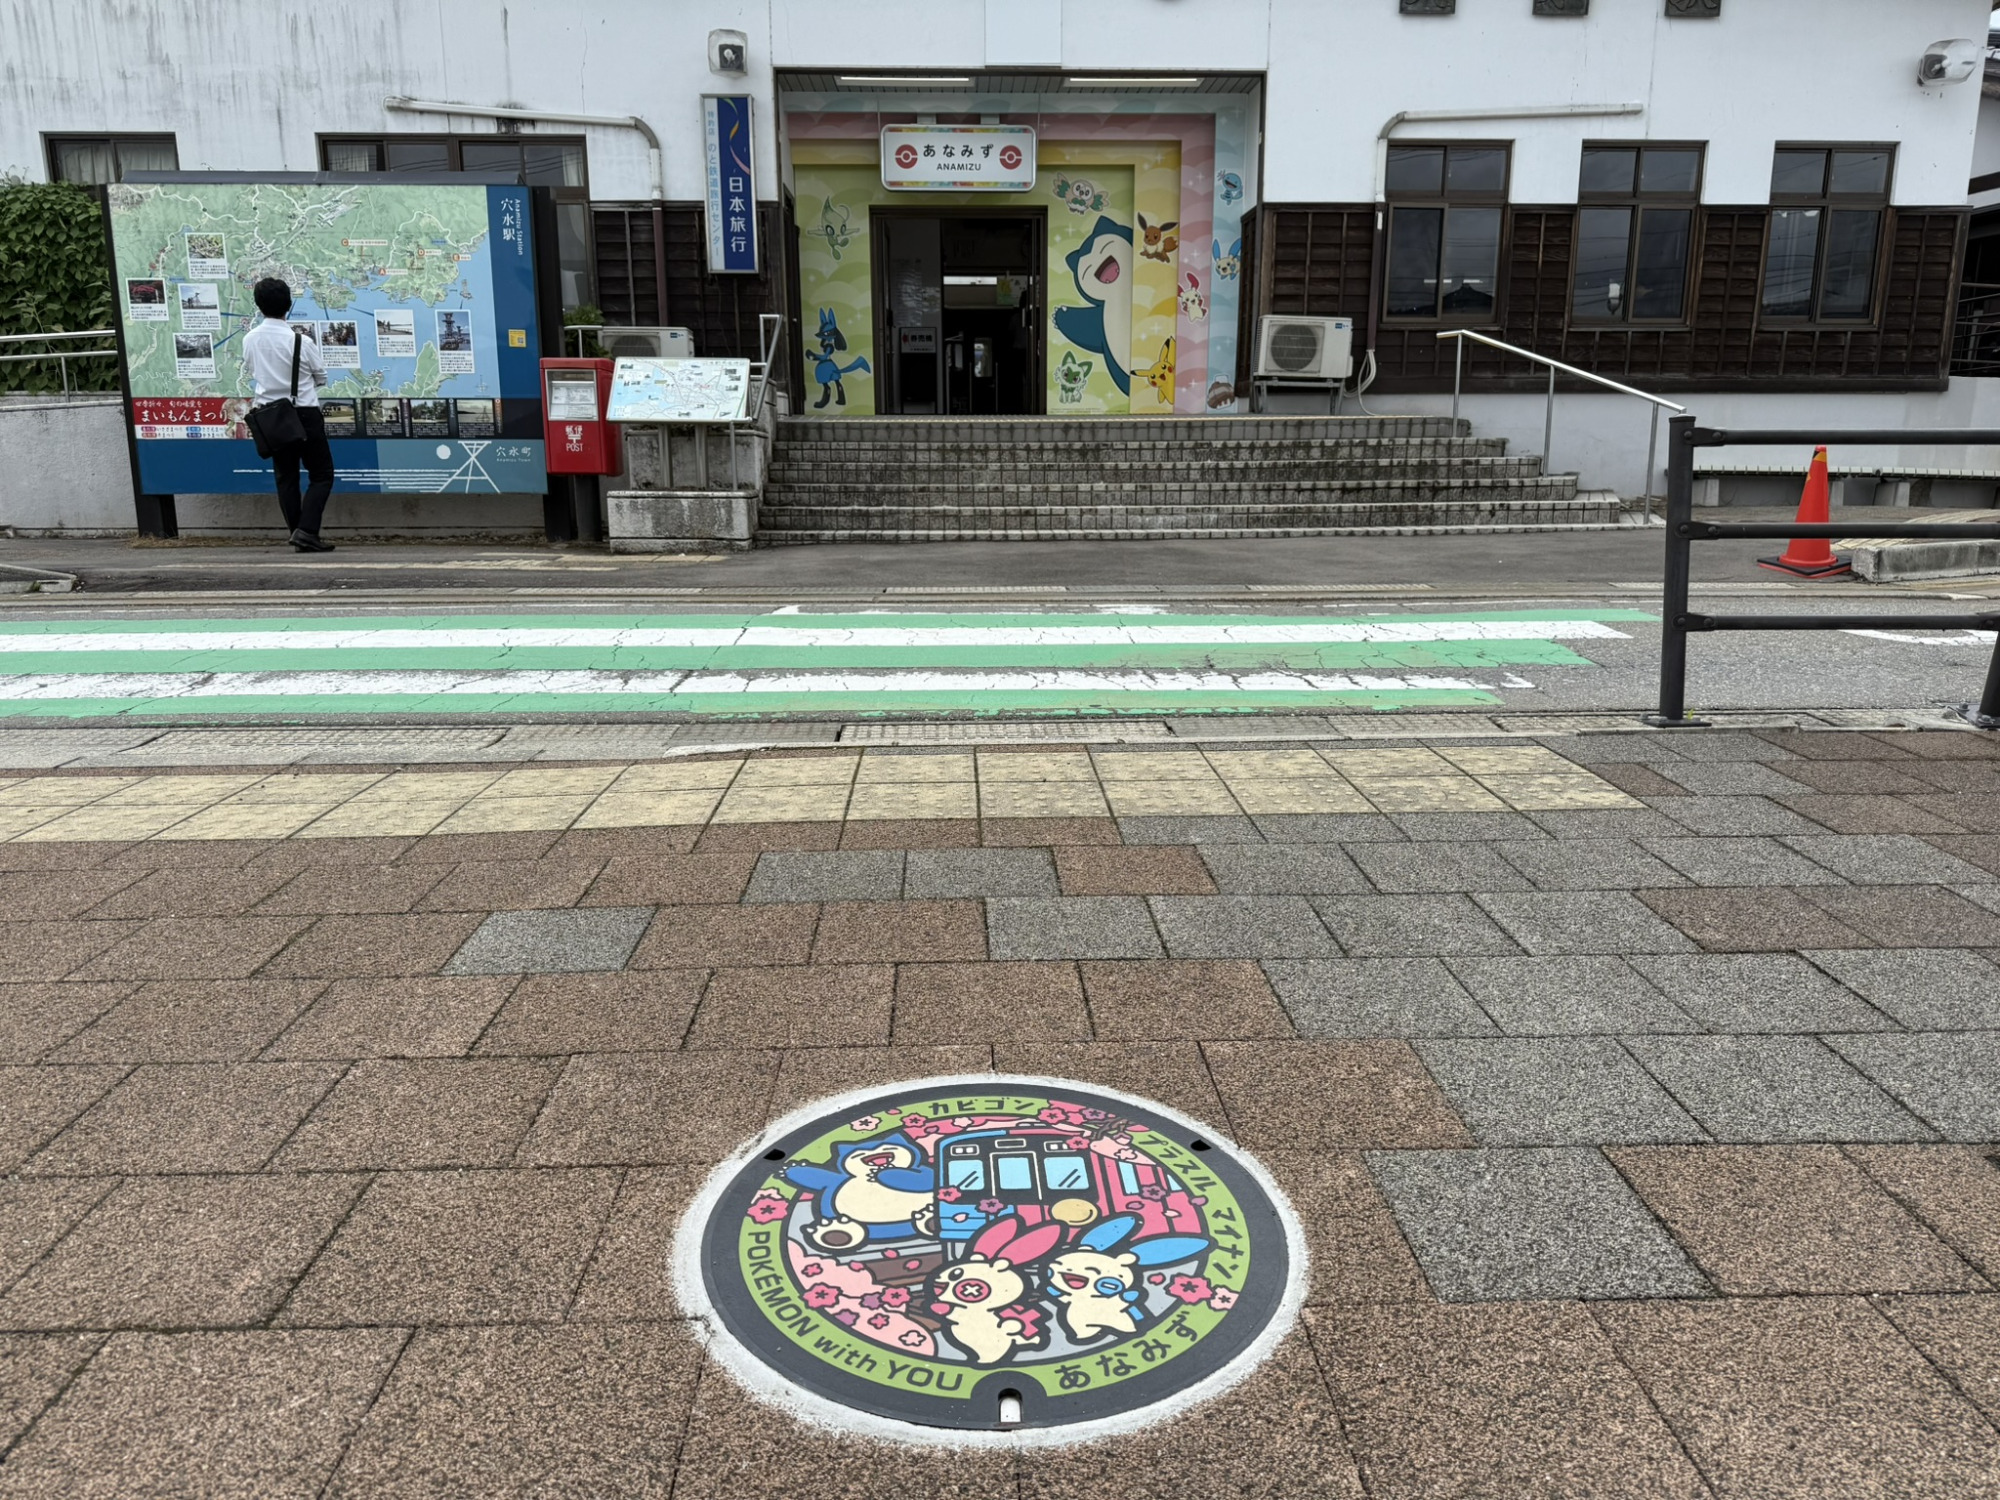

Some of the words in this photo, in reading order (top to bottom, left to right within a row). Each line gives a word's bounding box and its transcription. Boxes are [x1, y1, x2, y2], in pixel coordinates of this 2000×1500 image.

[922, 143, 995, 159] あなみず
[936, 162, 982, 172] ANAMIZU
[514, 198, 522, 230] Anamizu
[708, 143, 721, 256] のと鉄道旅行センター
[500, 197, 516, 241] 穴水駅
[728, 176, 747, 253] 日本旅行
[516, 230, 524, 256] Station
[140, 409, 228, 423] まいもんまつり
[565, 425, 583, 436] 郵便
[496, 446, 532, 457] 穴水町
[566, 443, 583, 452] POST
[928, 1096, 1035, 1116] カビゴン
[1138, 1134, 1218, 1193] プラスル
[1212, 1206, 1245, 1280] マイナン
[747, 1231, 820, 1338] POKÉMON
[813, 1335, 877, 1373] with
[886, 1359, 964, 1392] YOU
[1054, 1310, 1198, 1390] あなみず
